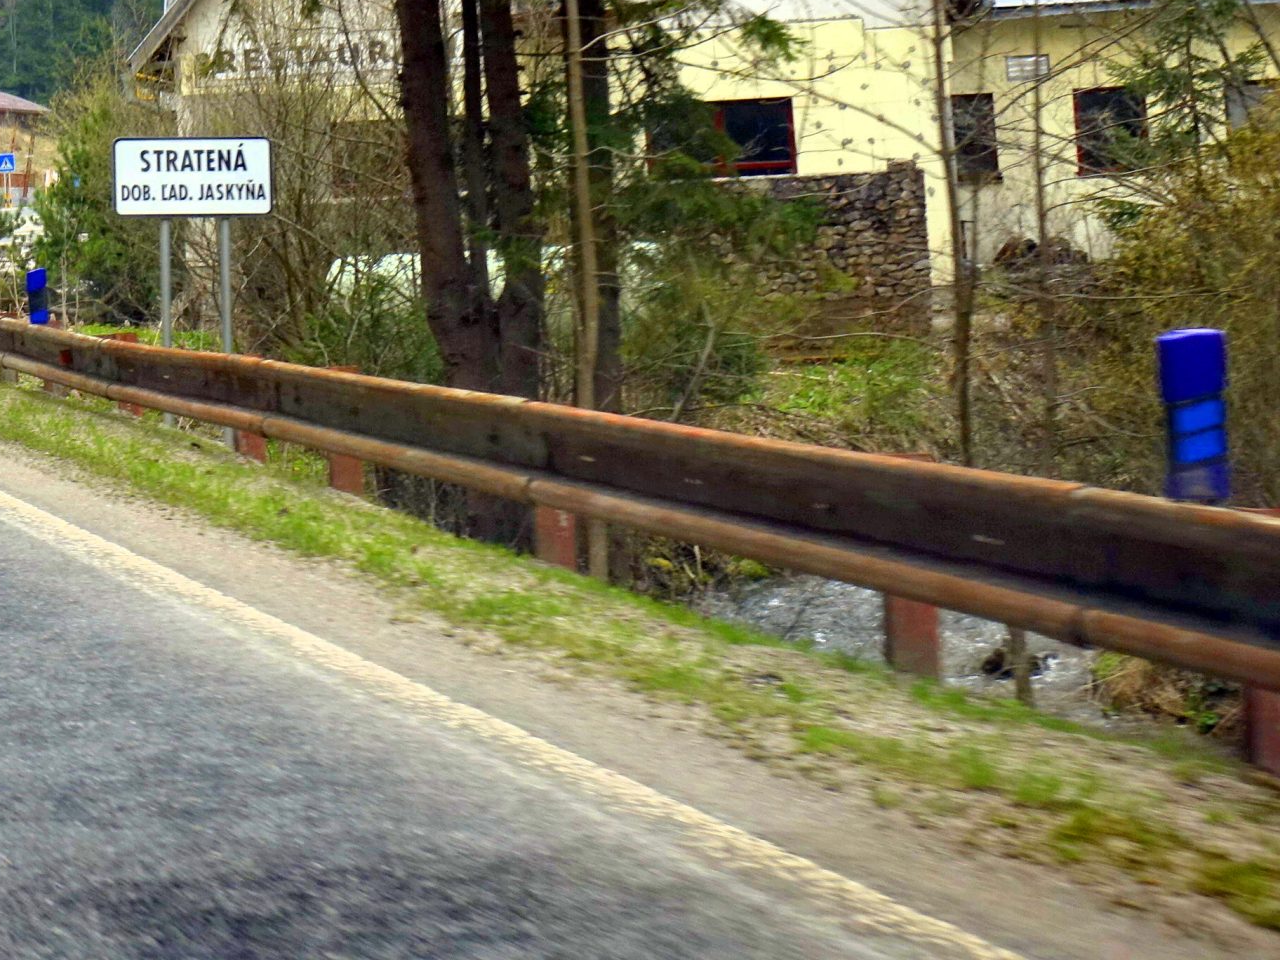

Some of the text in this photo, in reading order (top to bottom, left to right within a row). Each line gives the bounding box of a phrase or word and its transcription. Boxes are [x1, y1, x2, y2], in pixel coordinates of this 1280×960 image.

[140, 143, 248, 172] STRATENÁ
[121, 184, 156, 201] DOB.
[198, 179, 267, 201] JASKYŇA
